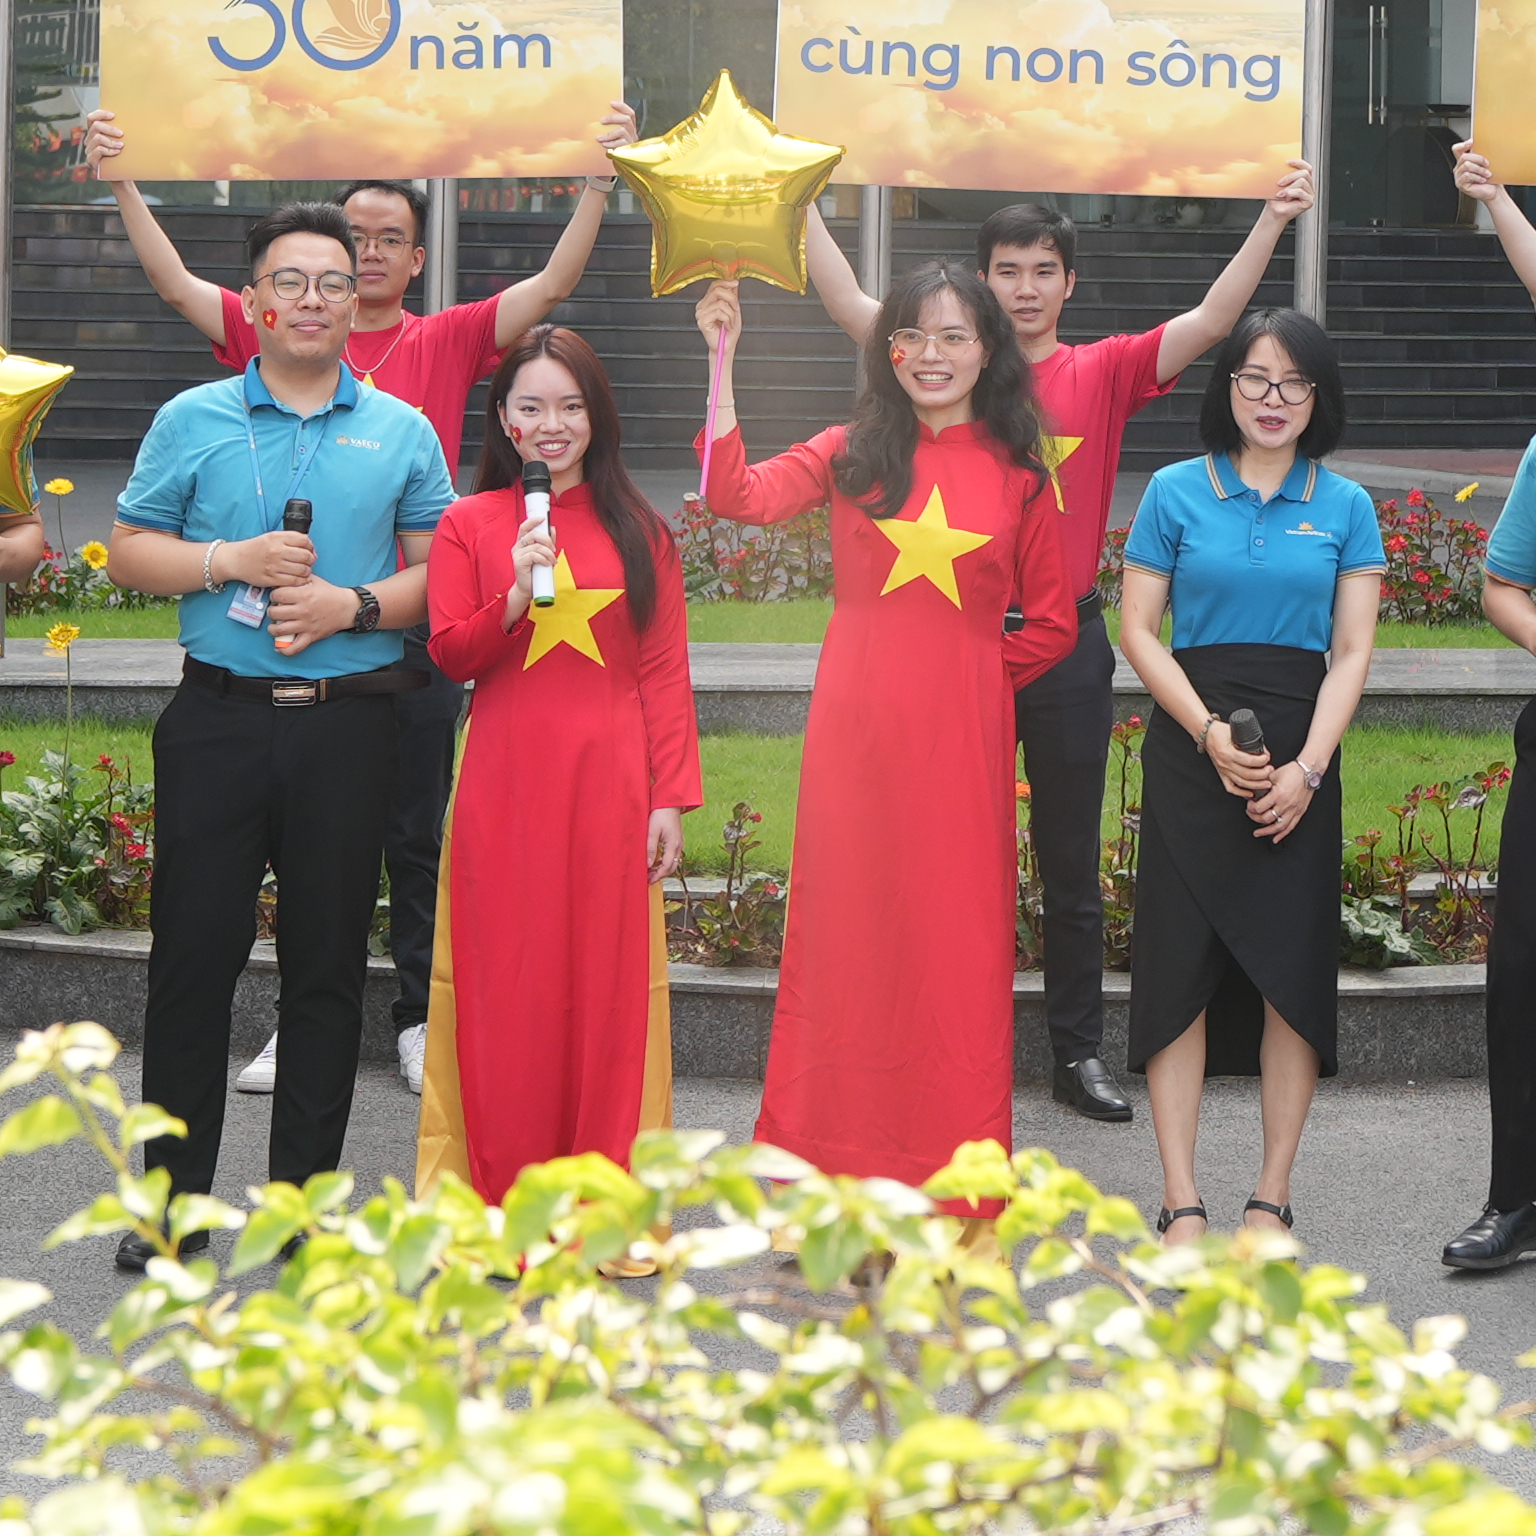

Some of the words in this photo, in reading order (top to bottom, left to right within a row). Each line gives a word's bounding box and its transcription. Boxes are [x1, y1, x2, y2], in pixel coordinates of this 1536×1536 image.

[410, 21, 551, 70] năm
[800, 25, 960, 91] cùng
[985, 44, 1104, 85] non
[1126, 39, 1281, 102] sông
